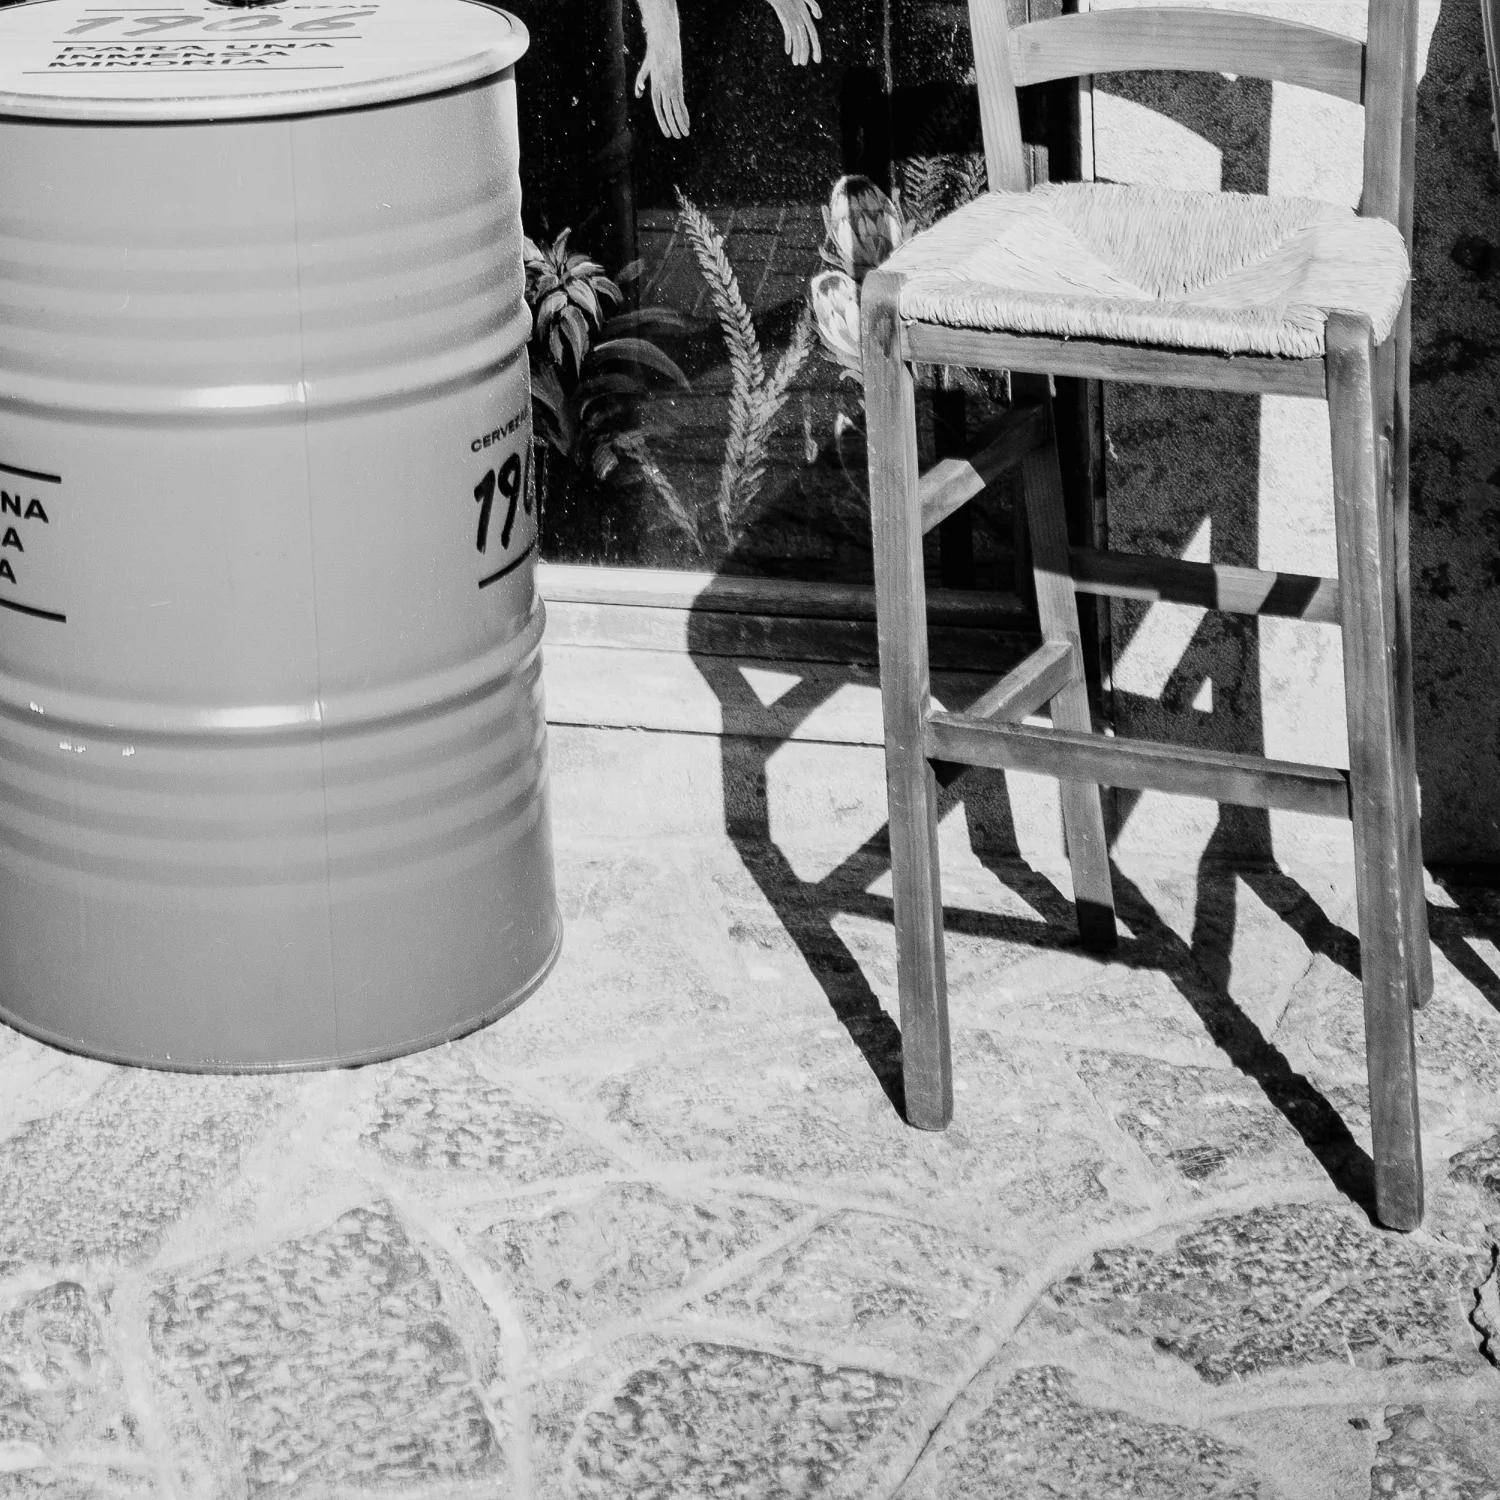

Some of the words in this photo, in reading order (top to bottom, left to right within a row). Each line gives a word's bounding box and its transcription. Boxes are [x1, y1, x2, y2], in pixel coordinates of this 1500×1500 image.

[64, 10, 377, 37] 1906
[62, 45, 206, 53] PARA
[225, 42, 336, 51] UNA
[54, 50, 290, 60] INMENSA
